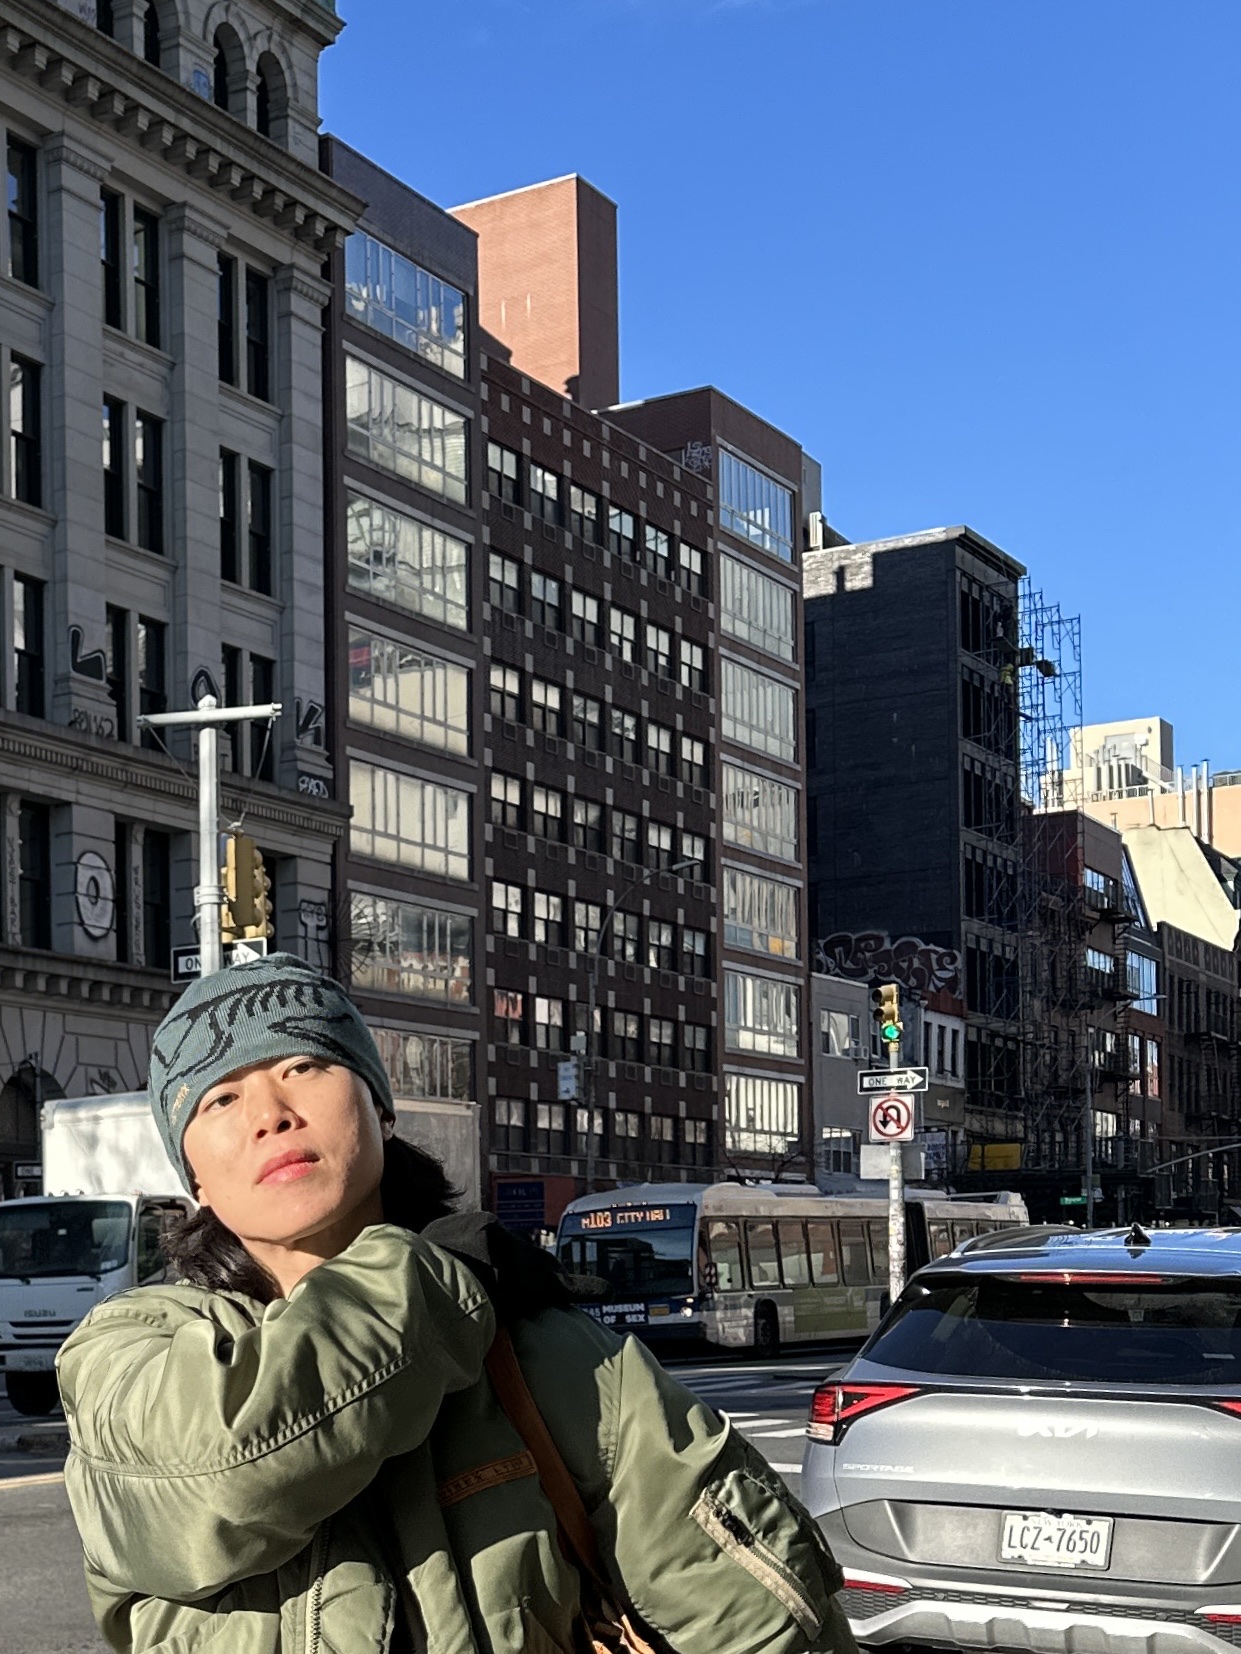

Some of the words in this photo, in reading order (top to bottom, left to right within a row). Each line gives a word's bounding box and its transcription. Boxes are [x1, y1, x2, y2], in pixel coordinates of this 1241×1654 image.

[868, 1077, 887, 1087] ONE
[897, 1076, 916, 1084] WAY
[581, 1211, 612, 1229] M103
[602, 1303, 645, 1314] MUSEUM
[603, 1315, 617, 1324] OF
[625, 1314, 645, 1323] SEX
[842, 1463, 915, 1474] SPORTAGE
